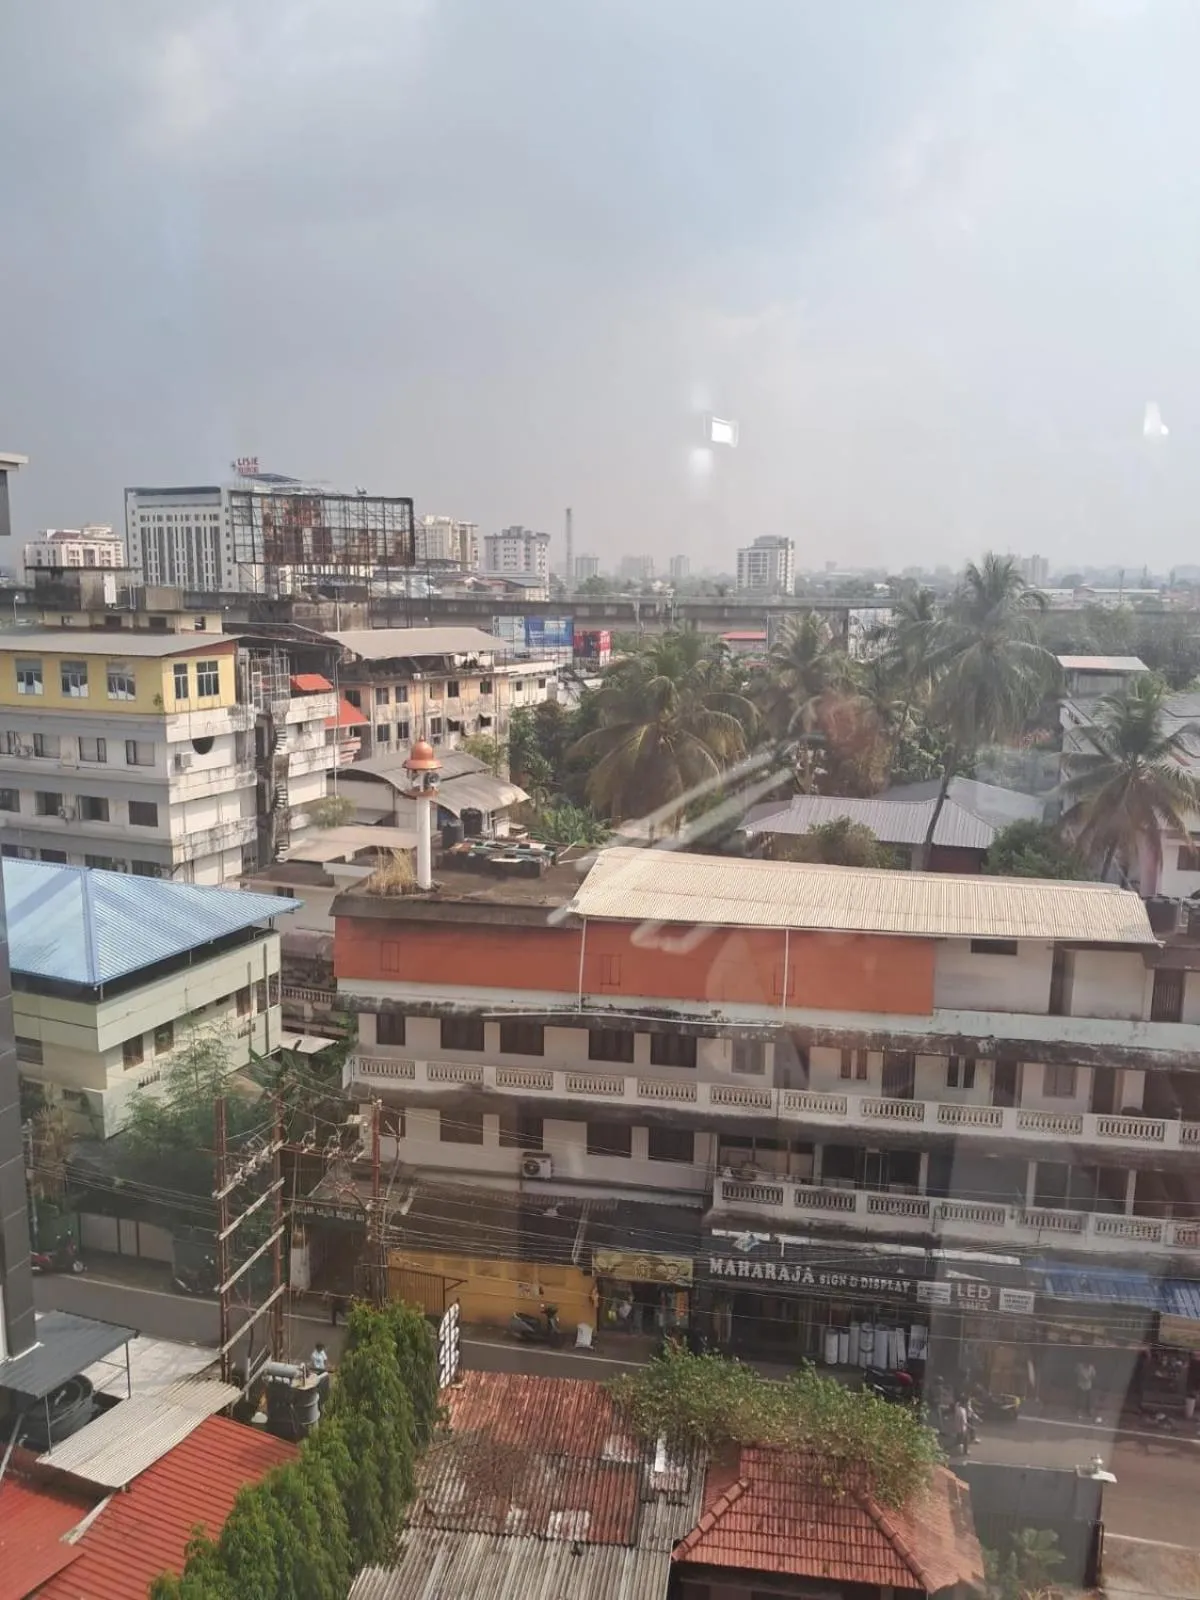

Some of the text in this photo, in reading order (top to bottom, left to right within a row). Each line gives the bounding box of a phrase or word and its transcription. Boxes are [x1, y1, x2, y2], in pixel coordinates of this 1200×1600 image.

[709, 1257, 815, 1283] MAHARAJA
[820, 1273, 847, 1286] SIGN
[861, 1276, 911, 1294] DISPLAY
[957, 1282, 991, 1299] LED
